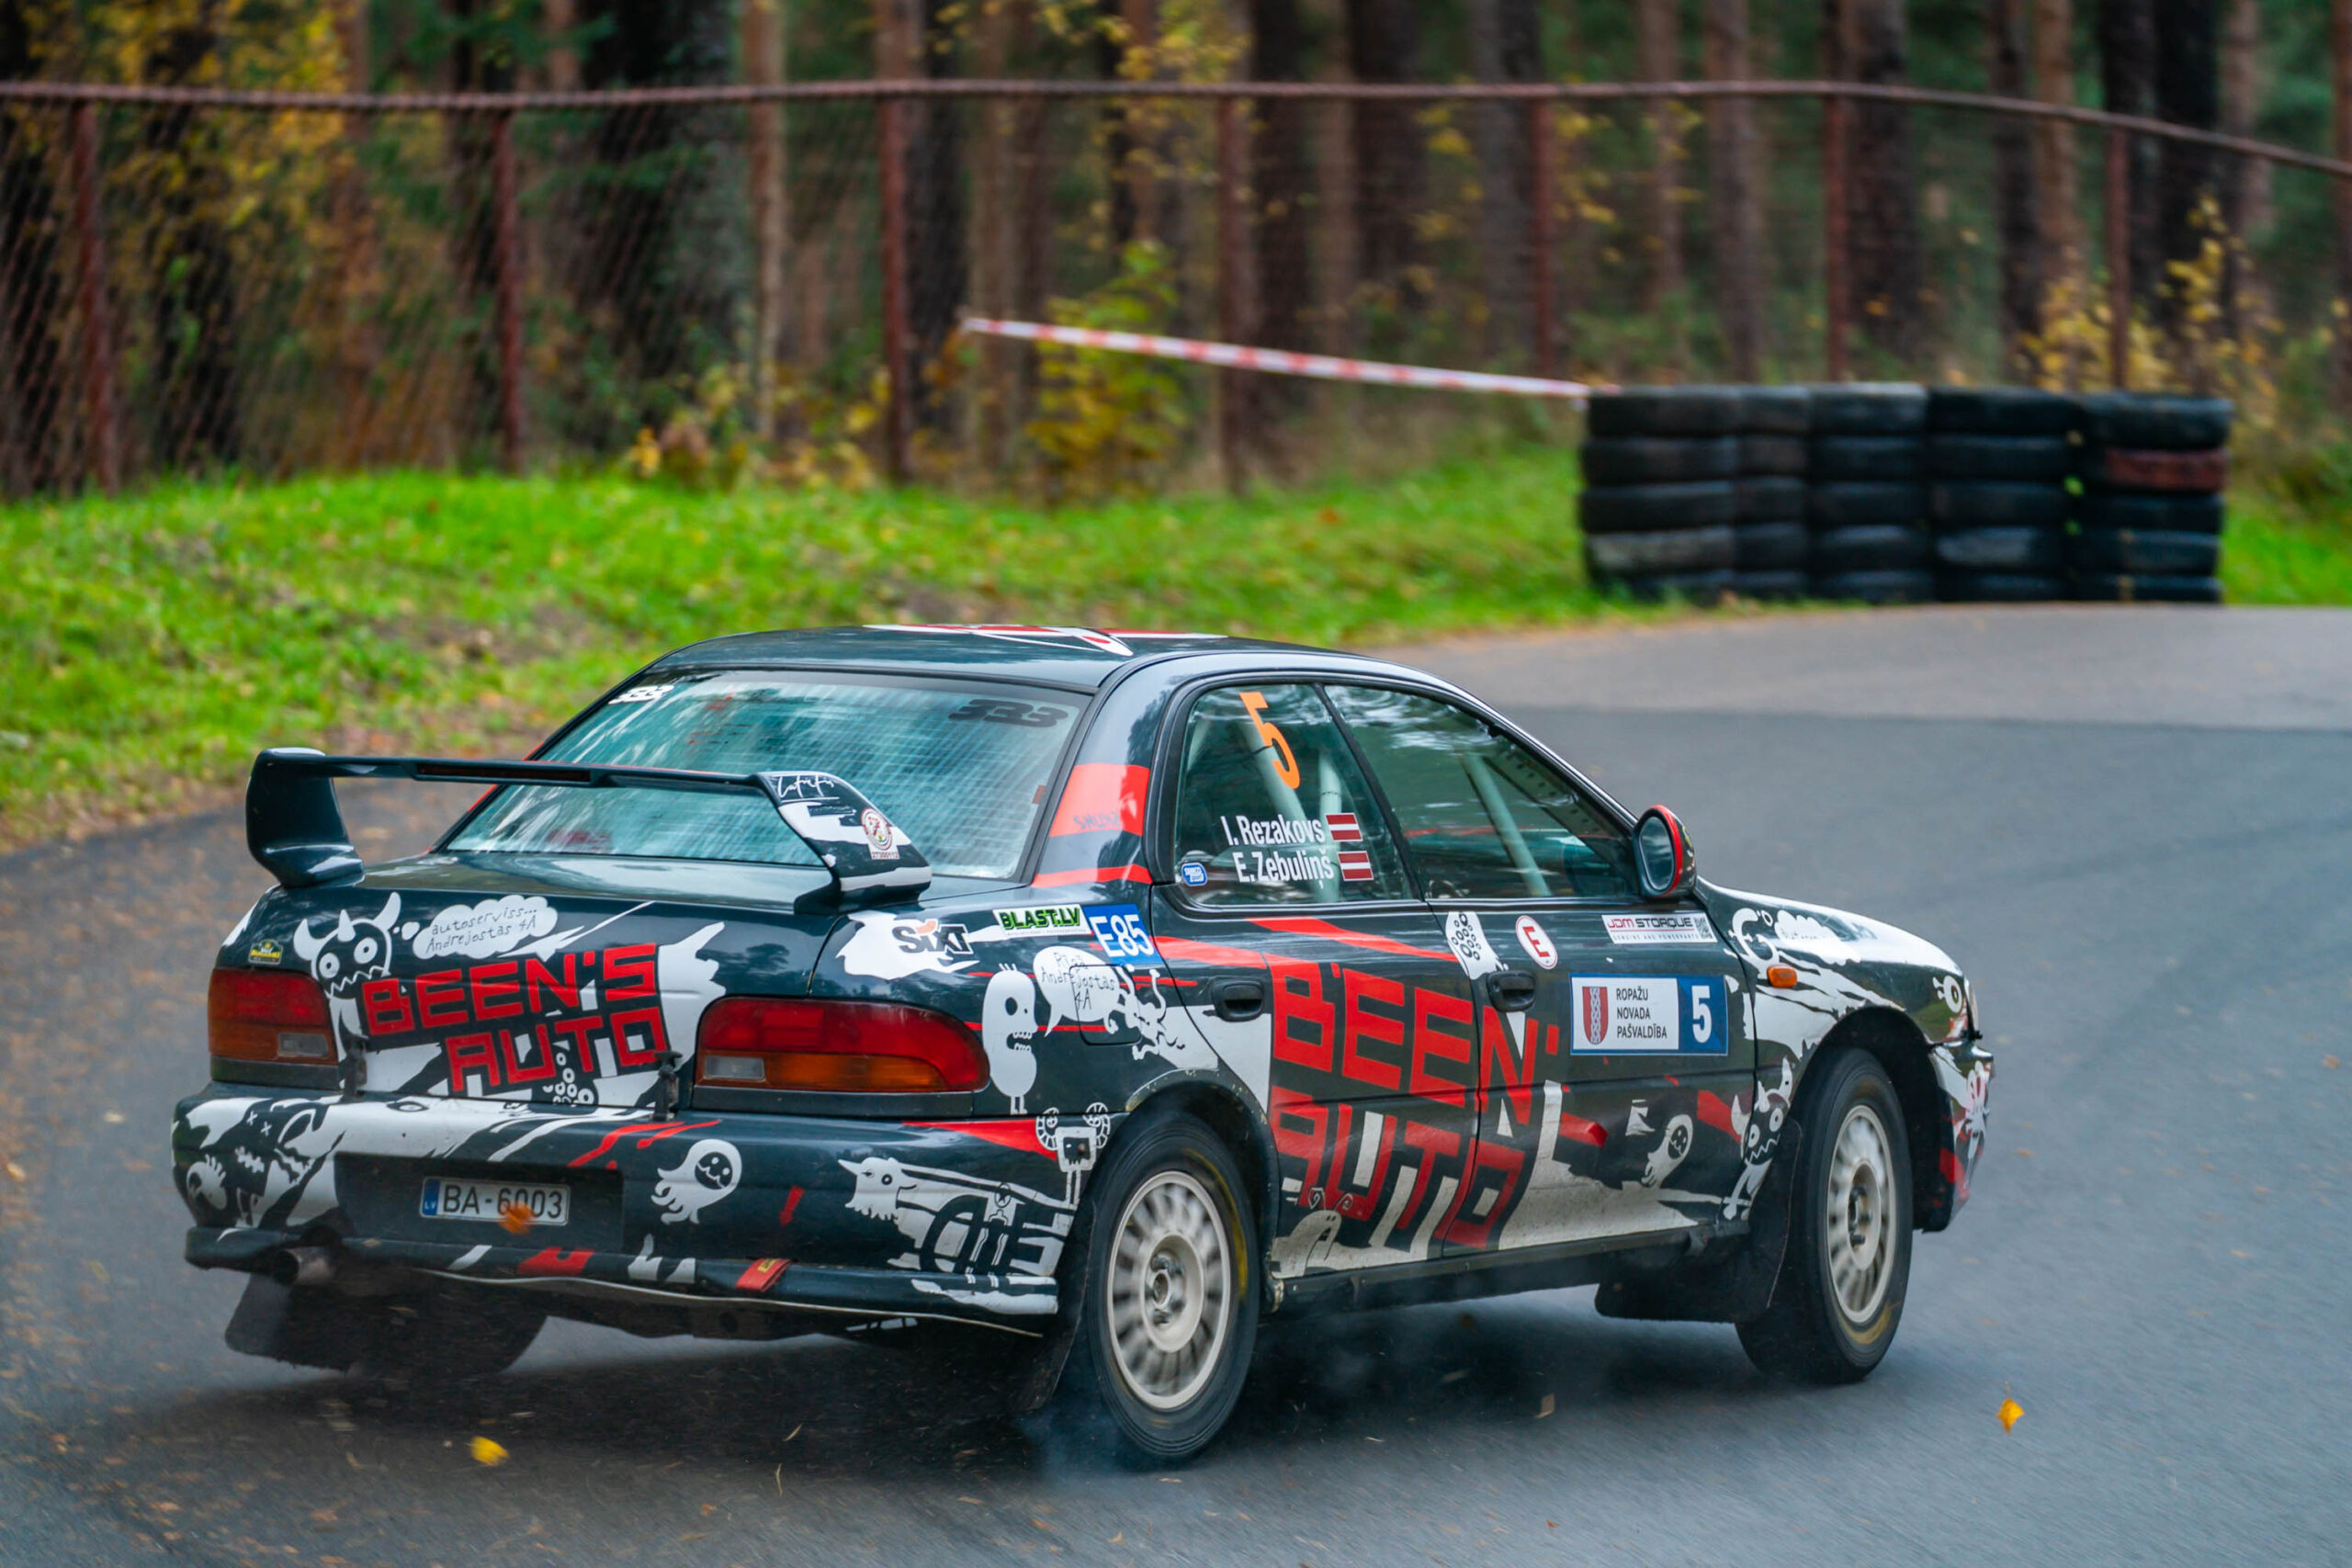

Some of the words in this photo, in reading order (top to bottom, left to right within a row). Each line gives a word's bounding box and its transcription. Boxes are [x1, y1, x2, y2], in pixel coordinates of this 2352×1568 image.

[1238, 691, 1301, 789] 5
[1236, 814, 1325, 845] Rezakovs
[999, 908, 1080, 931] BLAST.LV
[1607, 918, 1635, 929] JDM
[1090, 914, 1155, 958] E85
[1522, 926, 1550, 957] E
[362, 942, 657, 1036] BEEN'S
[1616, 986, 1648, 1001] ROPAŽU
[1617, 1007, 1651, 1021] NOVADA
[1691, 985, 1713, 1043] 5
[1617, 1023, 1668, 1040] PAŠVALDĪBA
[446, 1007, 667, 1092] AUTO
[1268, 1086, 1525, 1250] AUTO
[424, 1200, 436, 1210] LV
